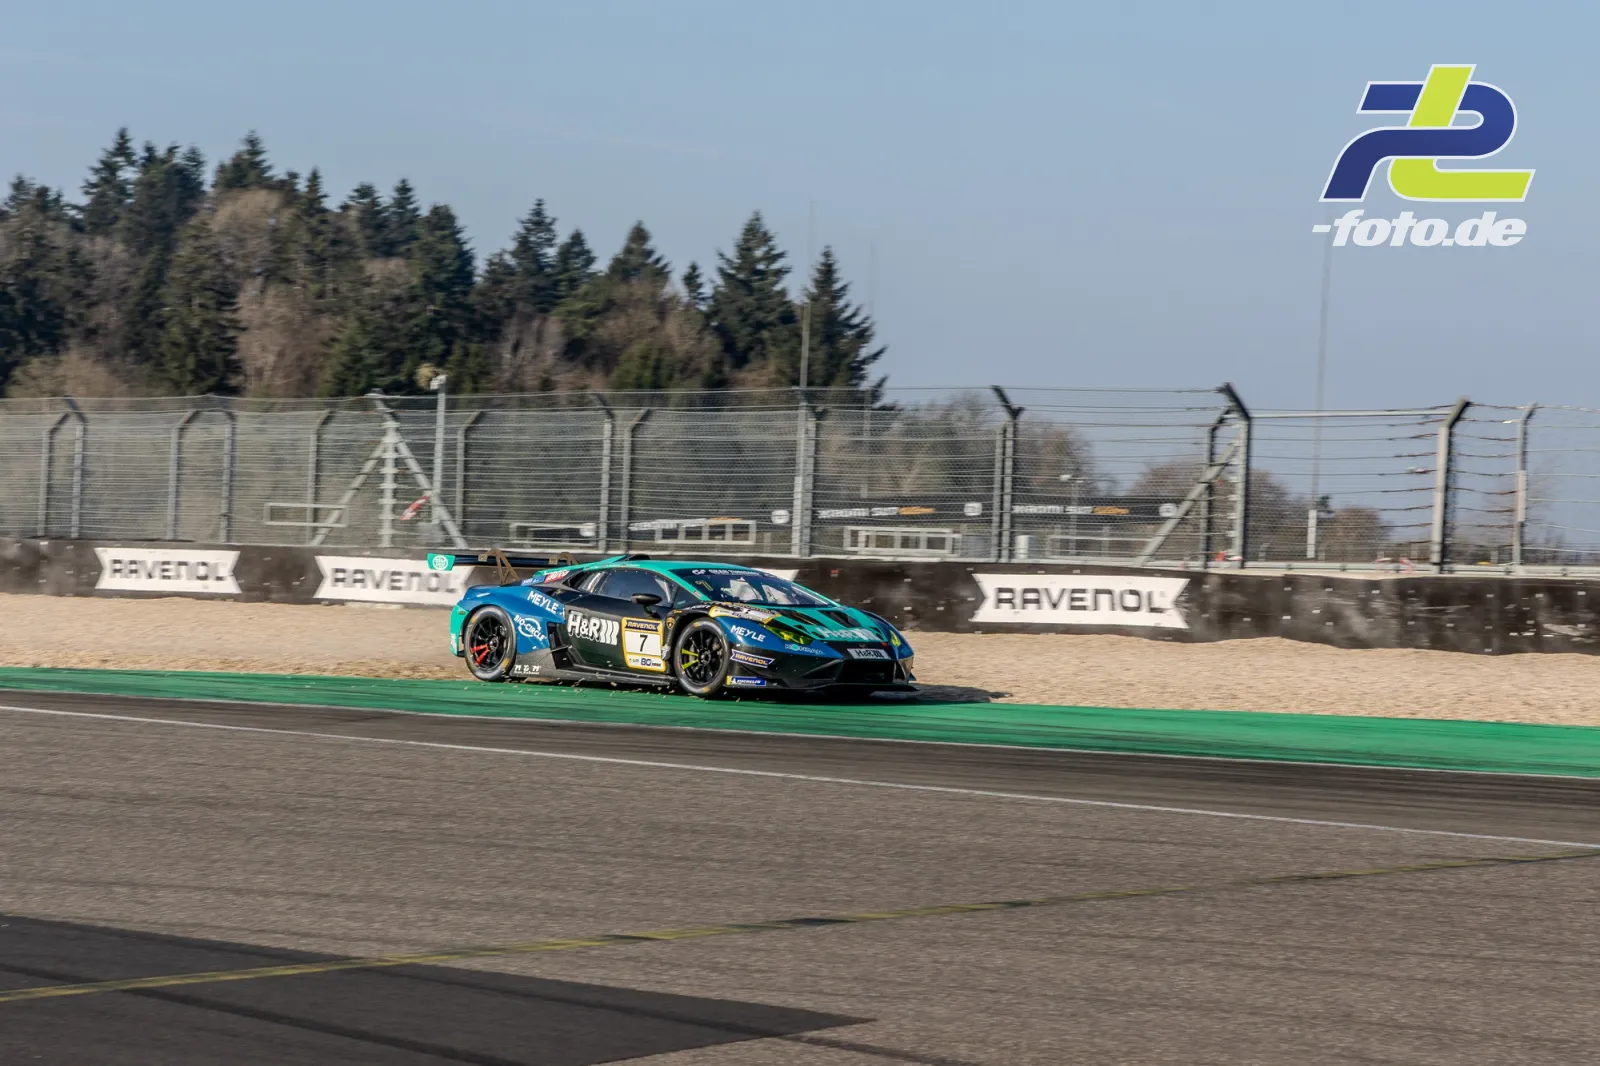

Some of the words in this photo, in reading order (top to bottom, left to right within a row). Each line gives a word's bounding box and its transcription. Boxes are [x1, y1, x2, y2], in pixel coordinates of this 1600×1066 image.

[109, 559, 227, 581] RAVENOL
[331, 568, 458, 593] RAVENOL
[527, 590, 559, 614] MEYLE
[995, 587, 1167, 613] RAVENOL
[514, 614, 547, 642] BIO-CIRCLE
[627, 621, 657, 630] RAVENOL
[731, 624, 766, 642] MEYLE
[640, 634, 648, 652] 7
[735, 653, 768, 665] RAVENOL
